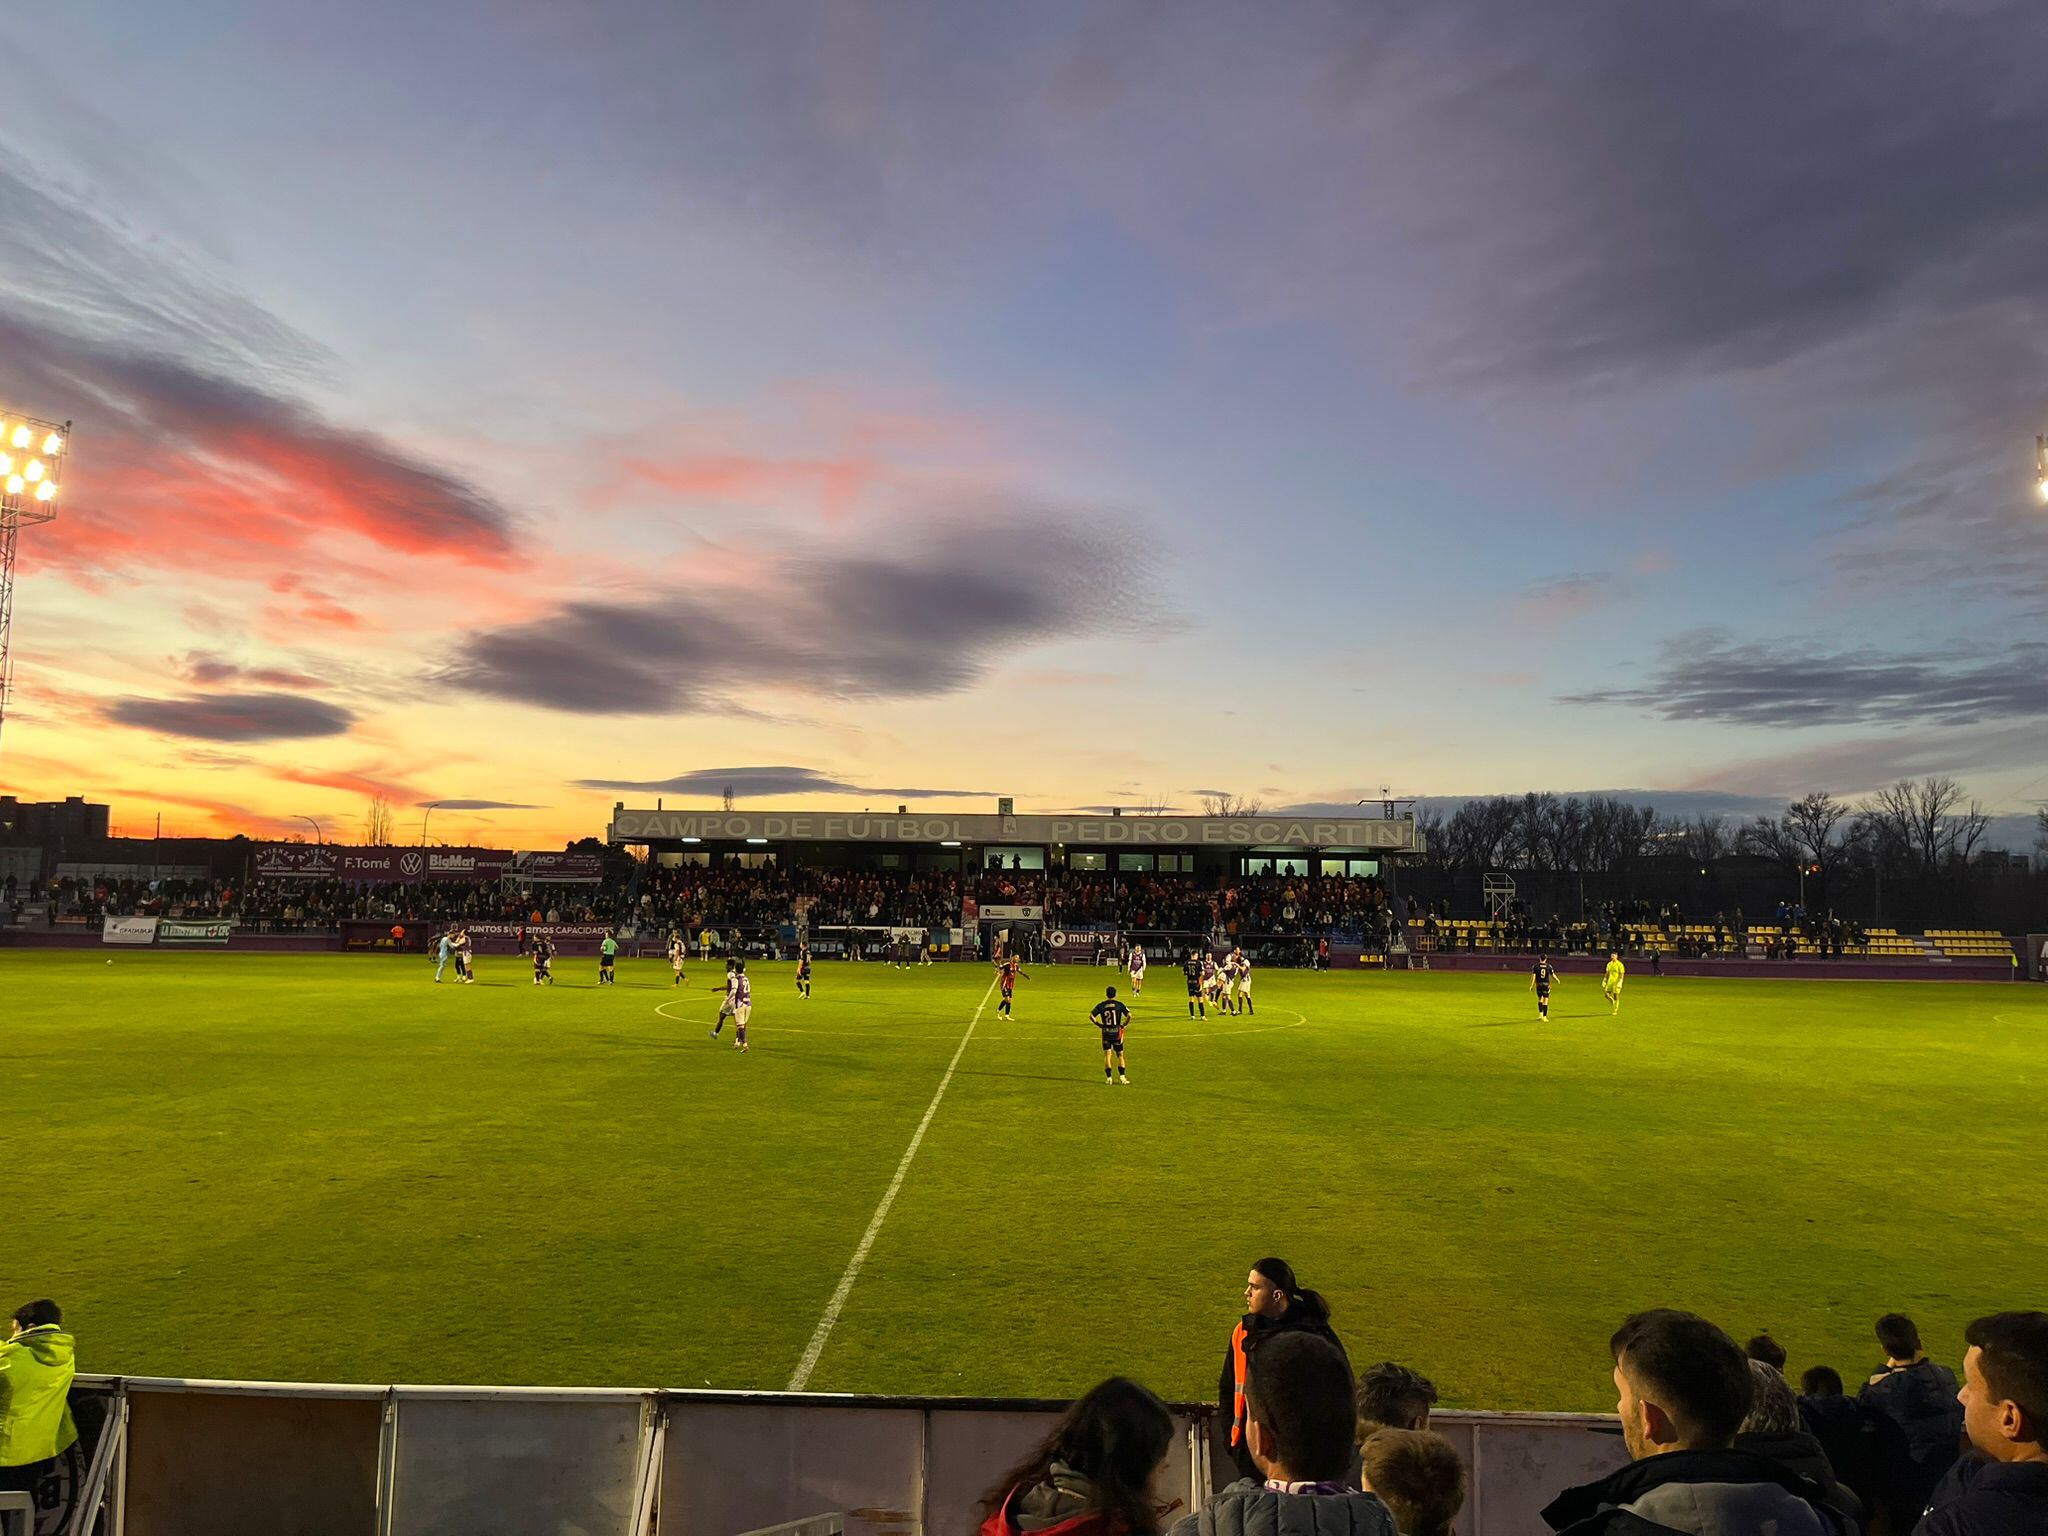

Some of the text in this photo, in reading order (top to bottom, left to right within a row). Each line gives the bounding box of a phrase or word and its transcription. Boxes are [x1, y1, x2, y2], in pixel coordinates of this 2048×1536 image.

[617, 815, 752, 837] CAMPO
[764, 817, 813, 838] DE
[1051, 821, 1189, 842] PEDRO
[256, 848, 296, 863] ATIENZA
[298, 848, 338, 863] ATIENZA
[344, 857, 391, 869] F.Tomé
[429, 854, 476, 868] BigMat
[467, 926, 502, 934] JUNTOS
[1540, 968, 1546, 979] 9
[1104, 1010, 1117, 1026] 21
